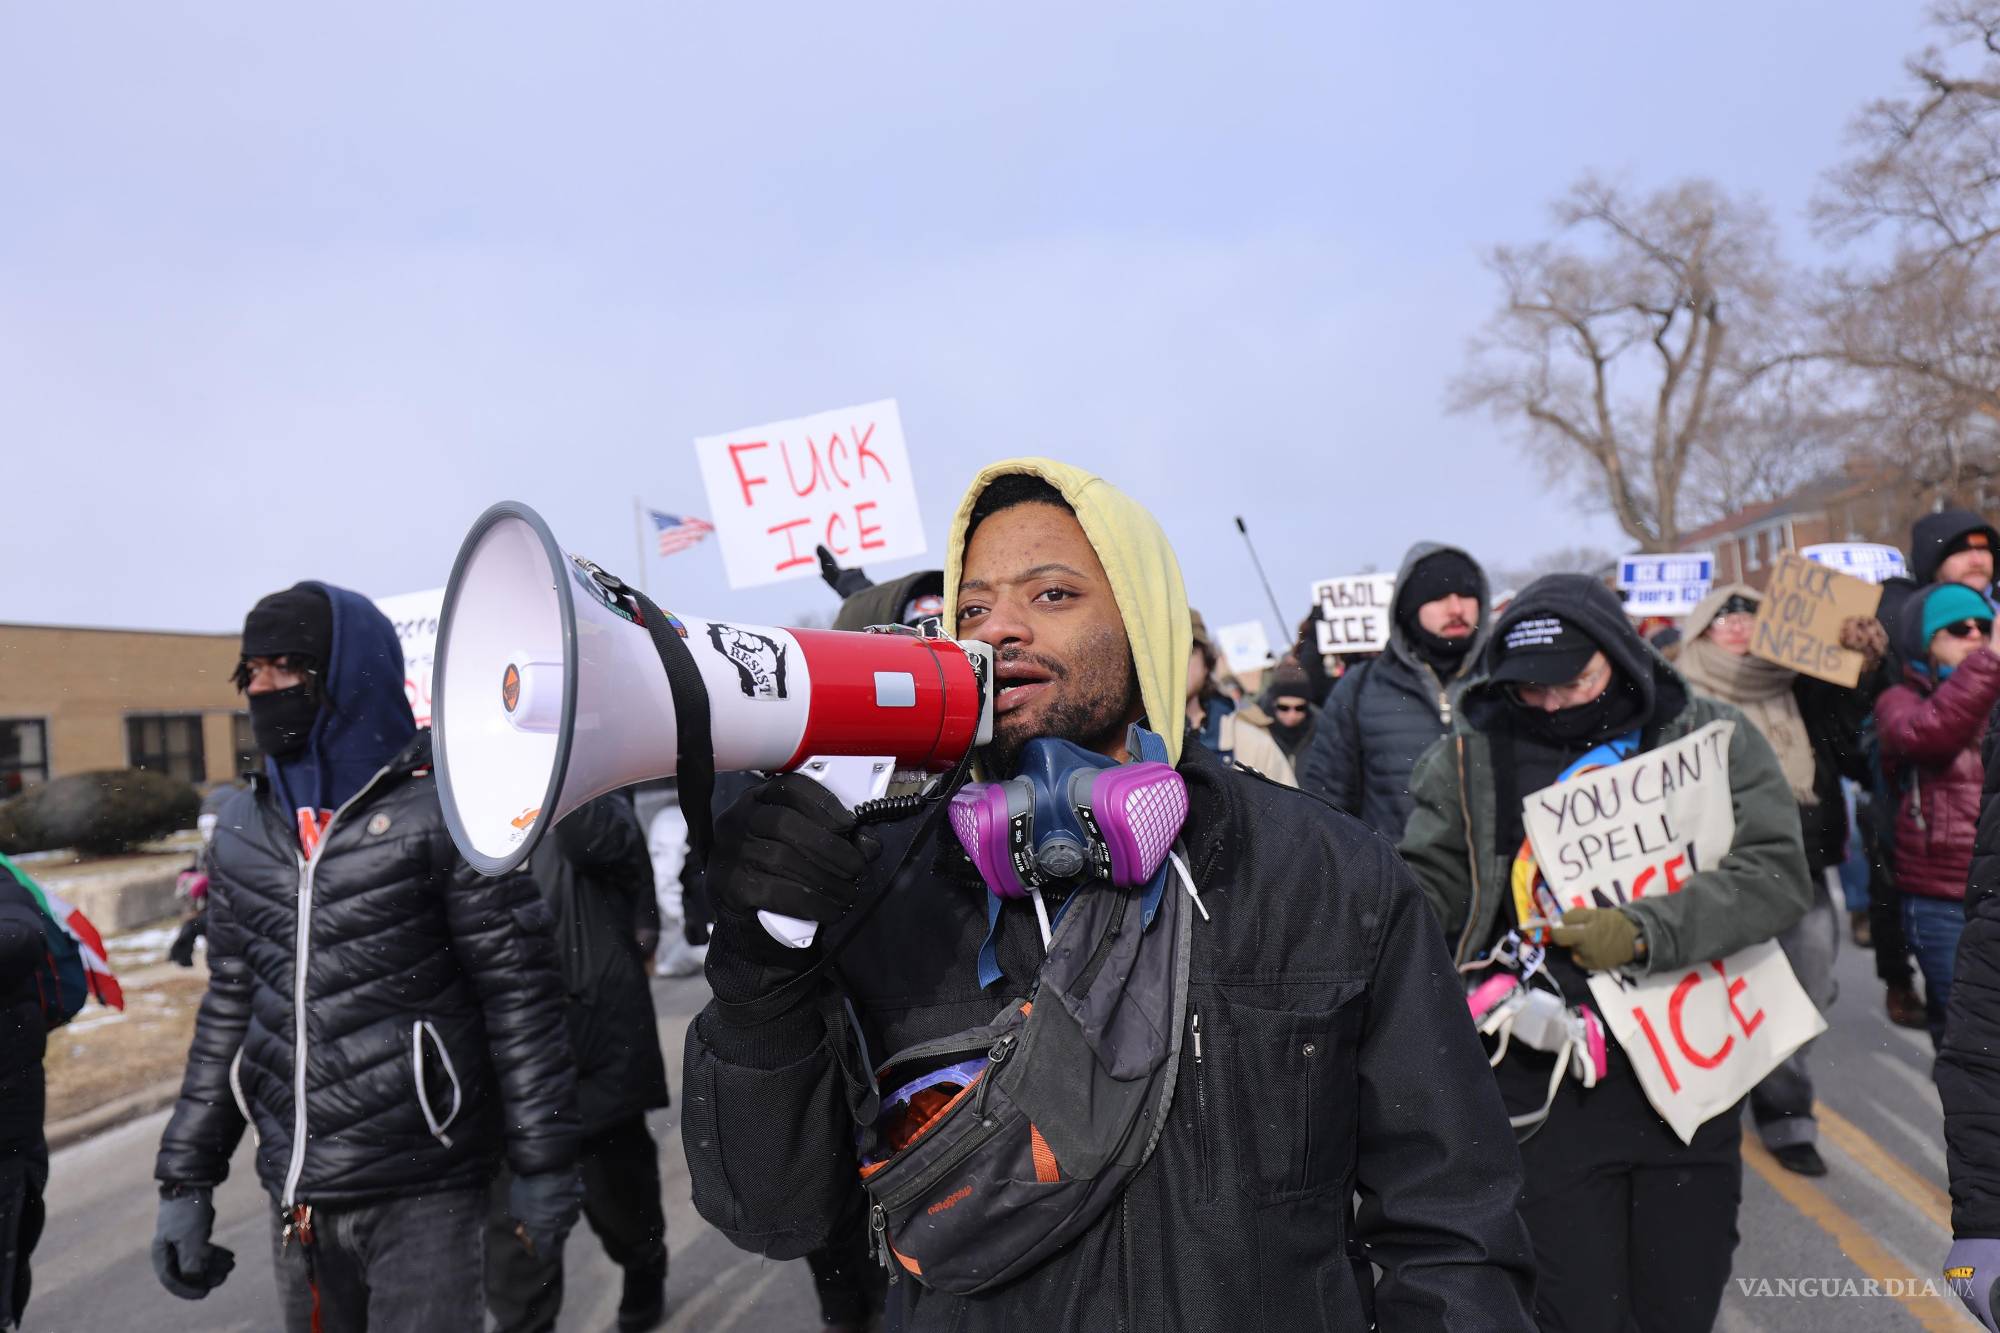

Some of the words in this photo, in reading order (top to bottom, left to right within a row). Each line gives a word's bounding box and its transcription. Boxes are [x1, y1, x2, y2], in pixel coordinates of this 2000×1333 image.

[728, 422, 892, 506] FUCK
[767, 501, 886, 571] ICE
[1770, 586, 1816, 630] YOU
[1779, 554, 1836, 606] FUCK
[1324, 616, 1376, 644] ICE
[1757, 621, 1842, 671] NAZIS
[730, 645, 774, 697] RESIST
[1540, 777, 1621, 835] YOU
[1632, 728, 1727, 804] CAN'T
[1559, 813, 1680, 882] SPELL
[1632, 959, 1766, 1094] ICE
